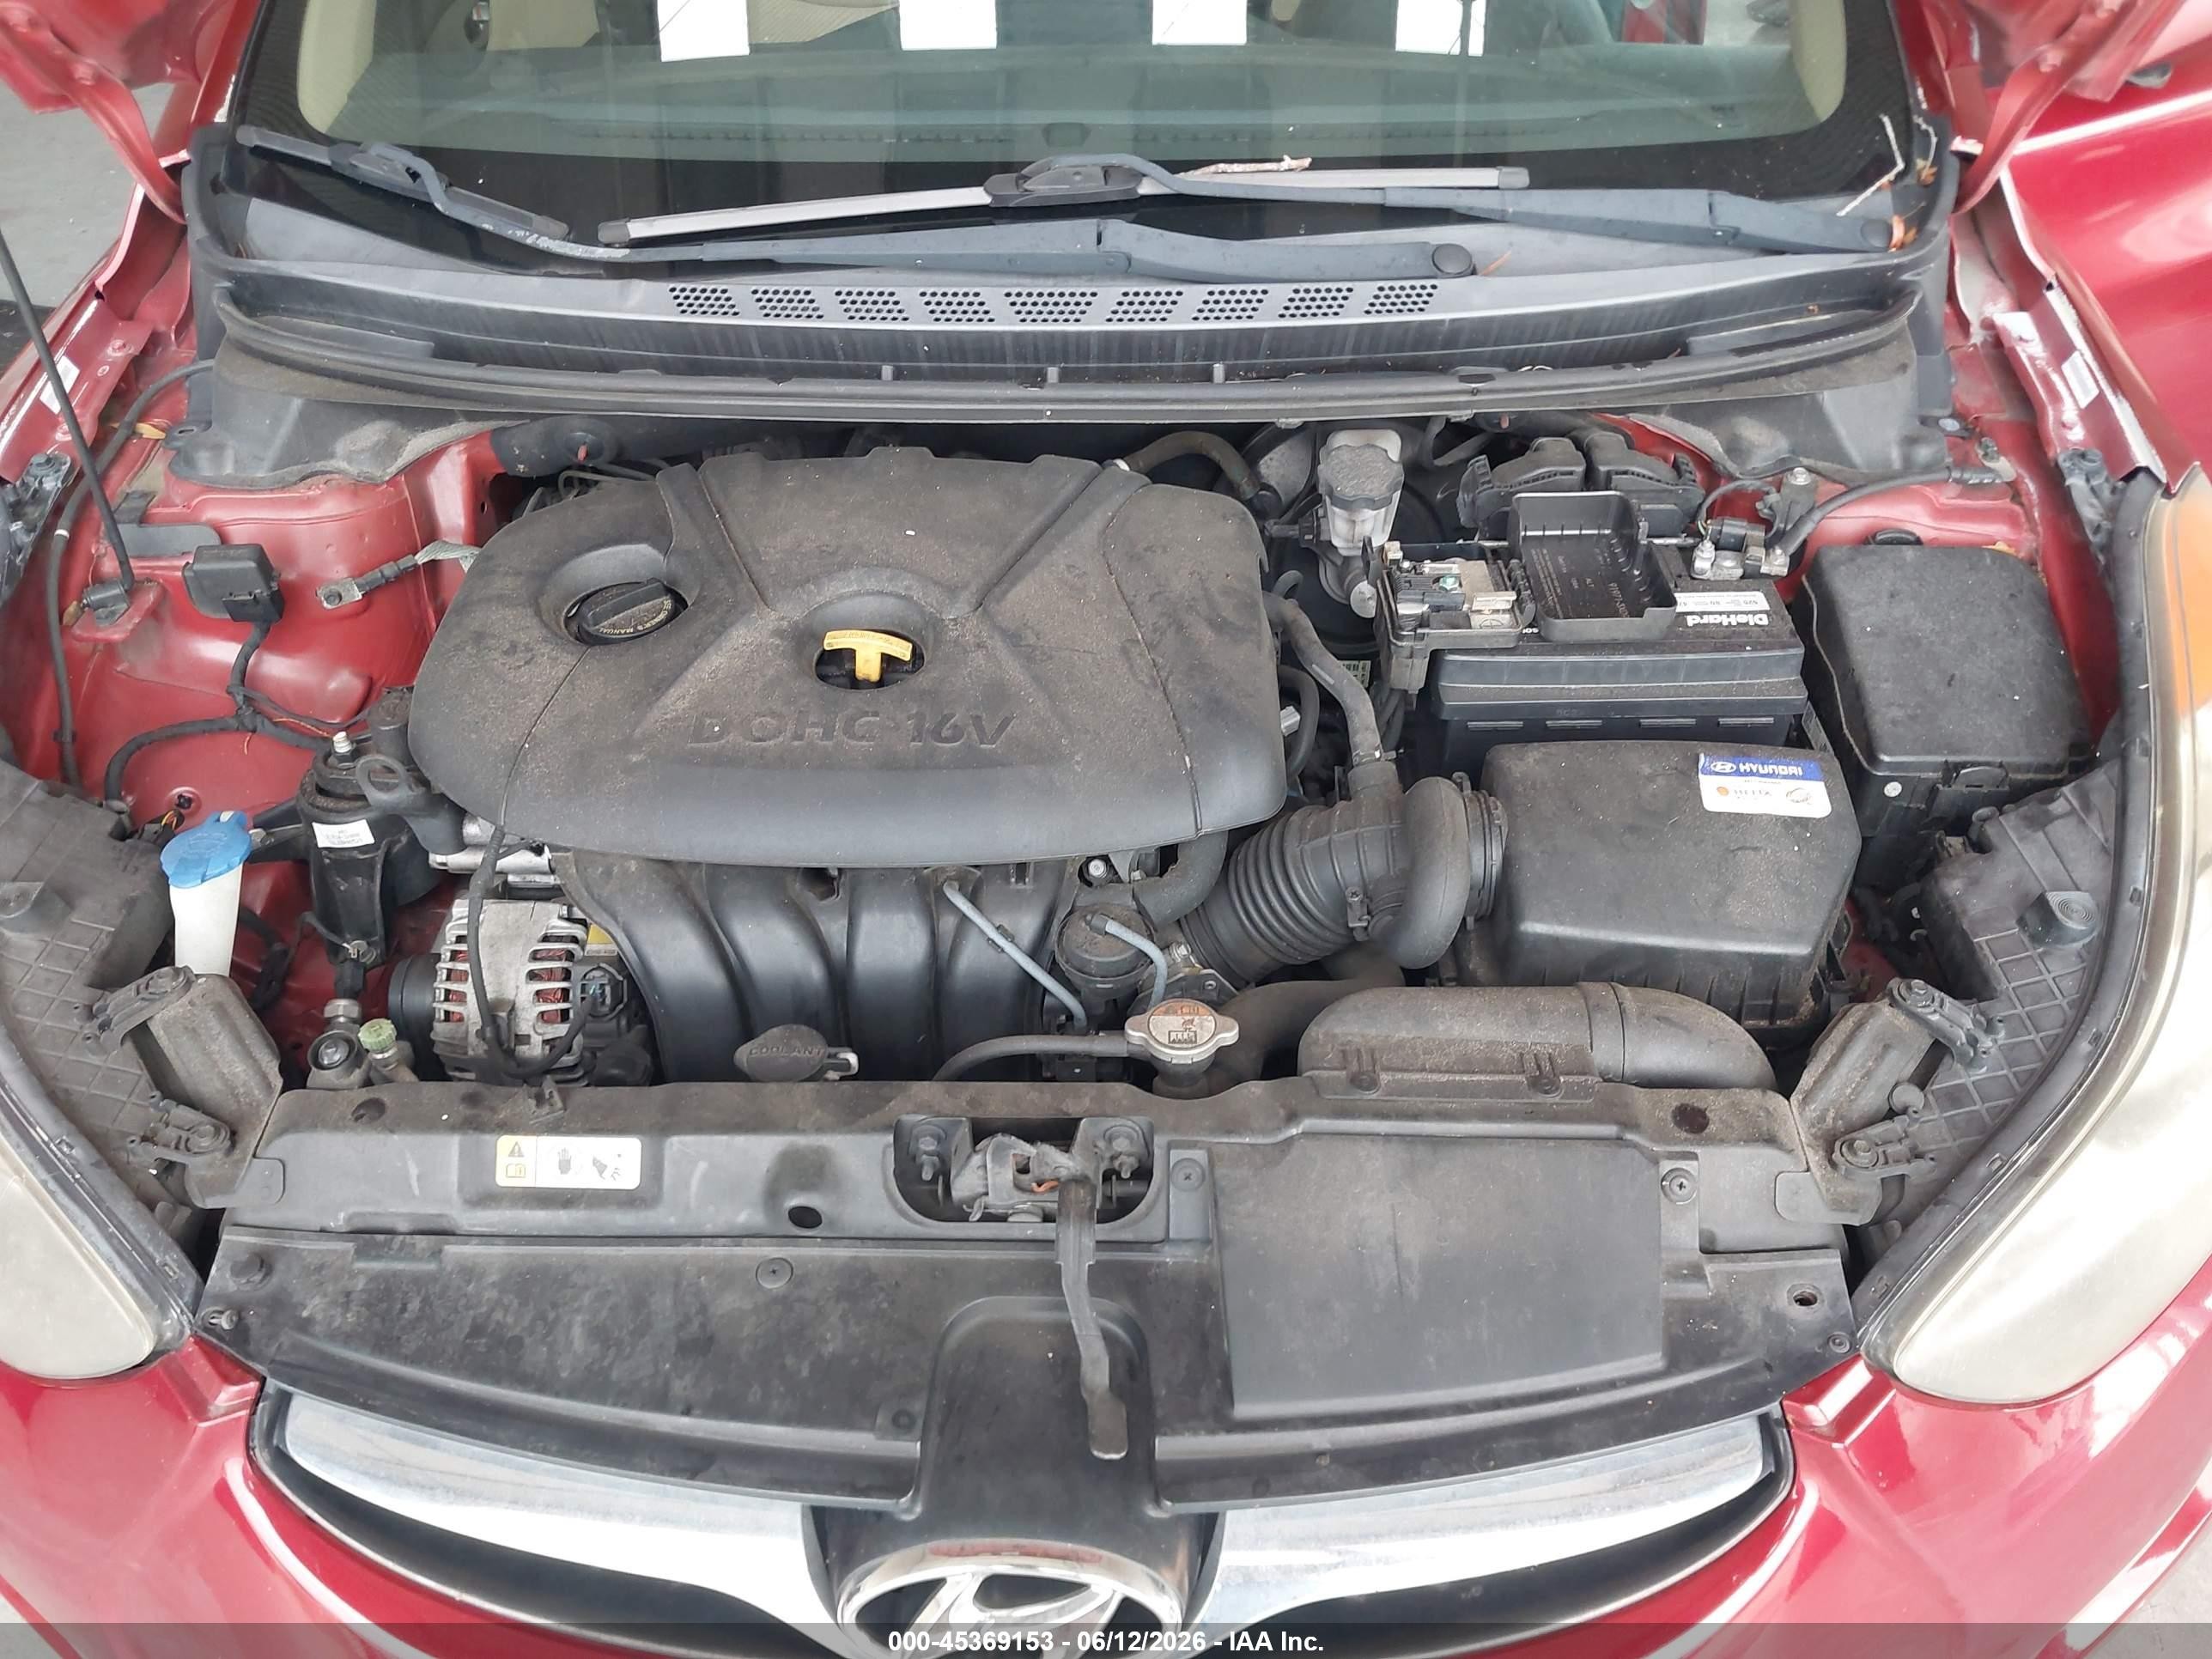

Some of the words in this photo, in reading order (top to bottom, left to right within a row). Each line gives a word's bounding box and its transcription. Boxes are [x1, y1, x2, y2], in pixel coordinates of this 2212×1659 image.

[1686, 613, 1769, 627] DieHard
[688, 712, 883, 744] DOHC
[907, 709, 1018, 748] 16V
[1739, 762, 1803, 776] HYUNDAI
[750, 1047, 825, 1057] COOLANT
